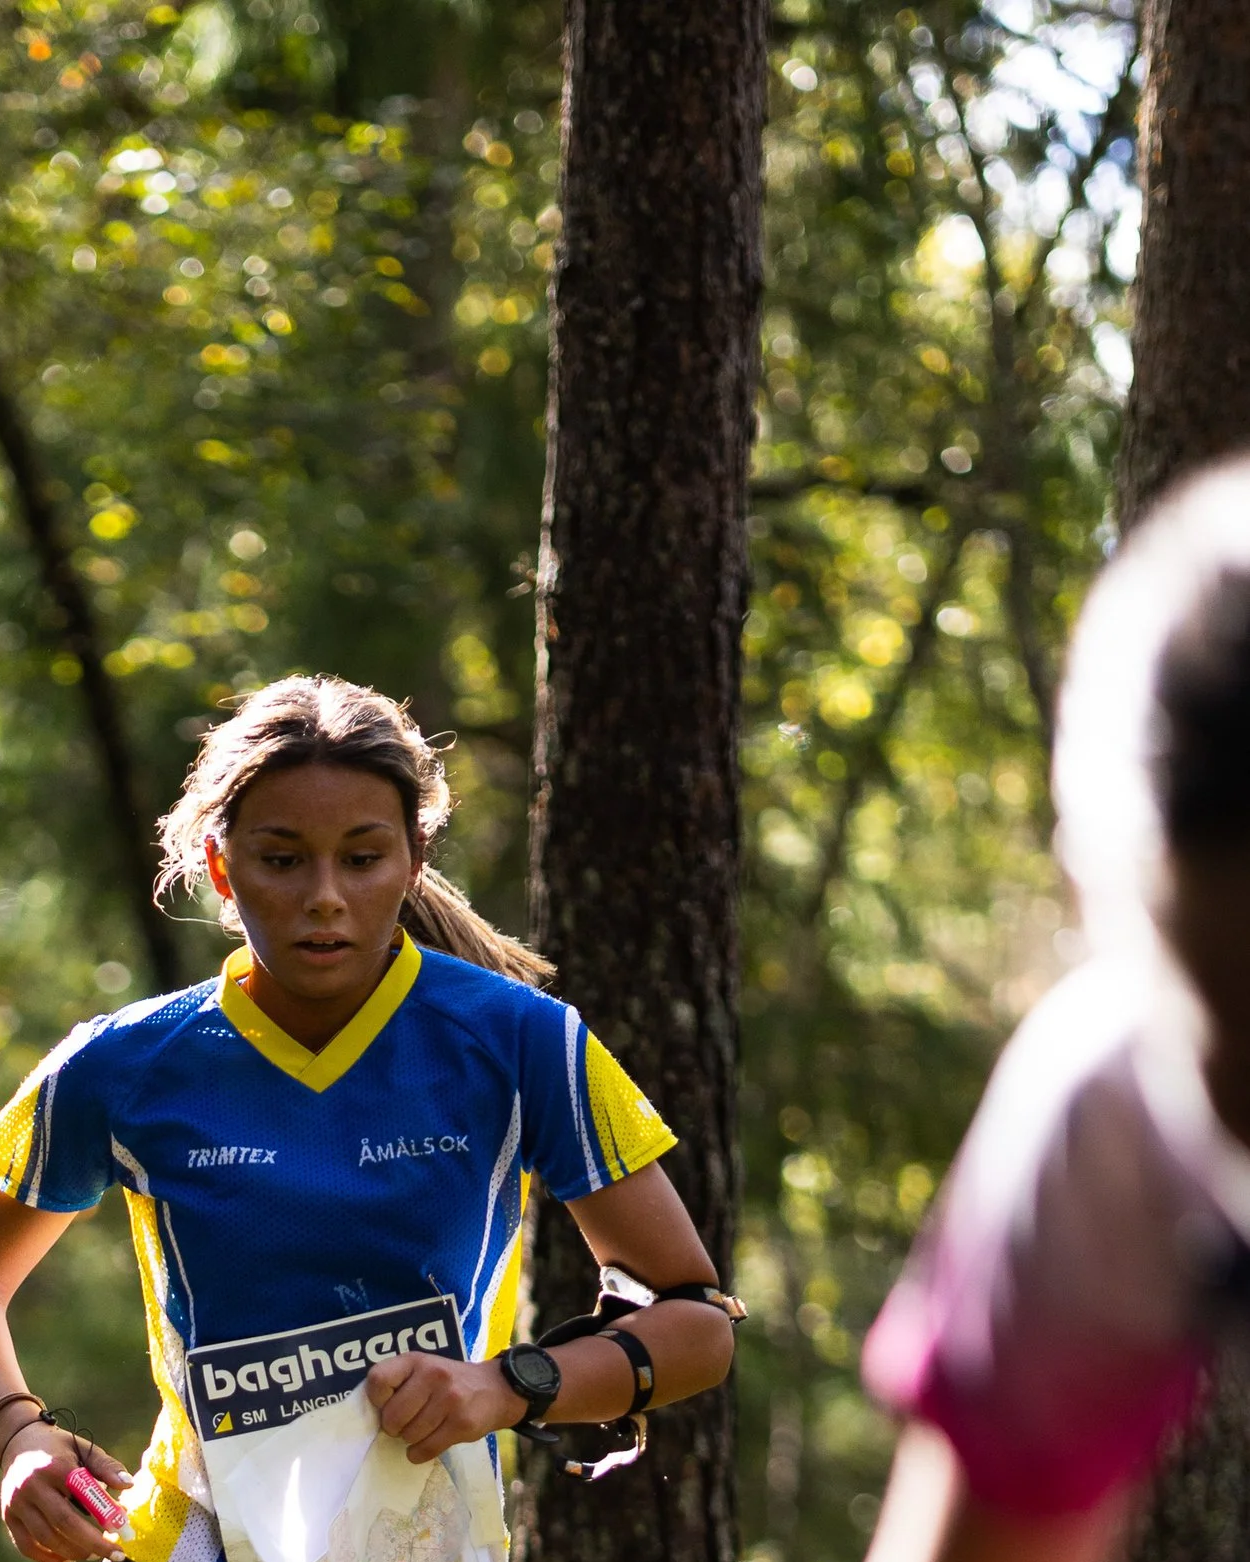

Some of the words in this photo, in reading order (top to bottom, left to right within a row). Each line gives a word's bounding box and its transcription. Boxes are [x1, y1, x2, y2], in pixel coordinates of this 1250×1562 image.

[187, 1145, 278, 1168] TRIMTEX
[202, 1319, 449, 1401] bagheera
[242, 1408, 268, 1426] SM
